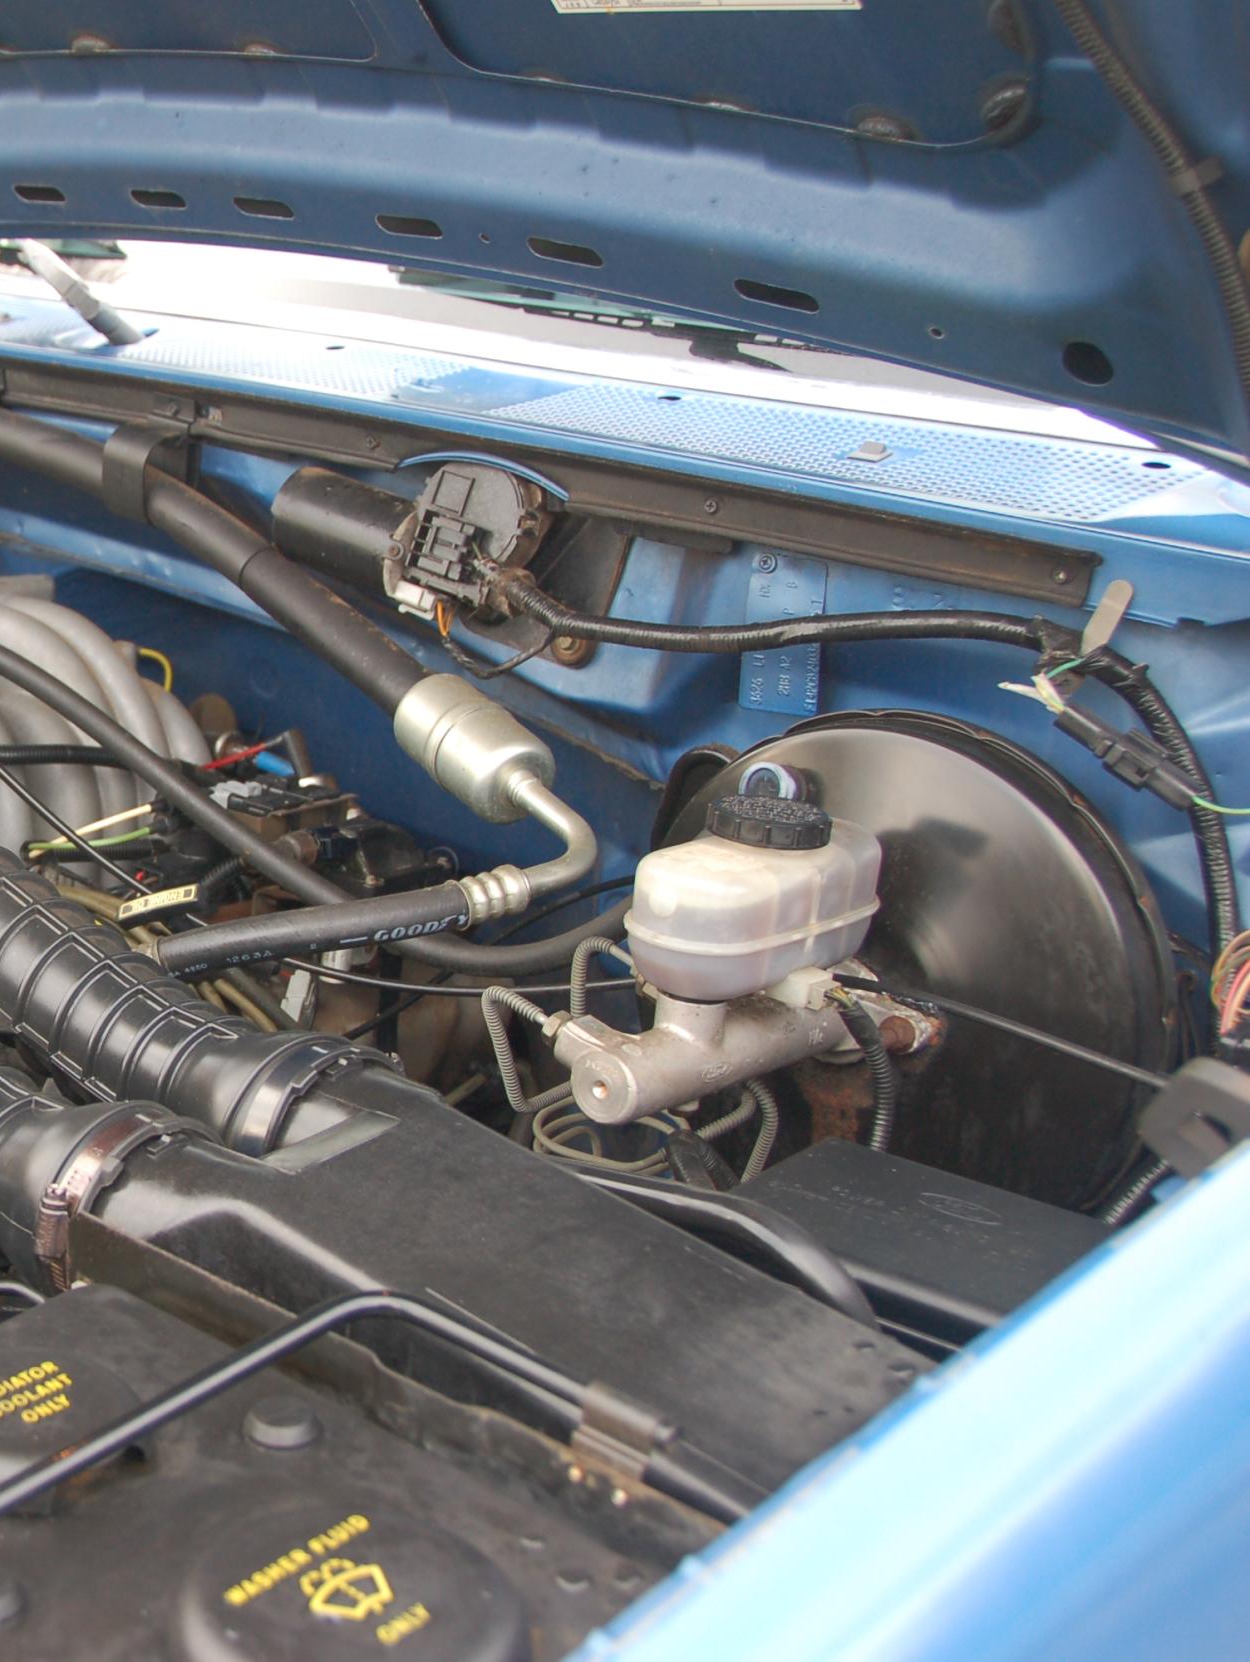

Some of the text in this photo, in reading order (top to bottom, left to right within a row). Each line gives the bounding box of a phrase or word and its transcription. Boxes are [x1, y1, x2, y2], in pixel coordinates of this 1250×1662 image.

[21, 1393, 70, 1424] ONLY
[223, 1514, 370, 1607] WASHER FLUID
[376, 1602, 431, 1646] ONLY
